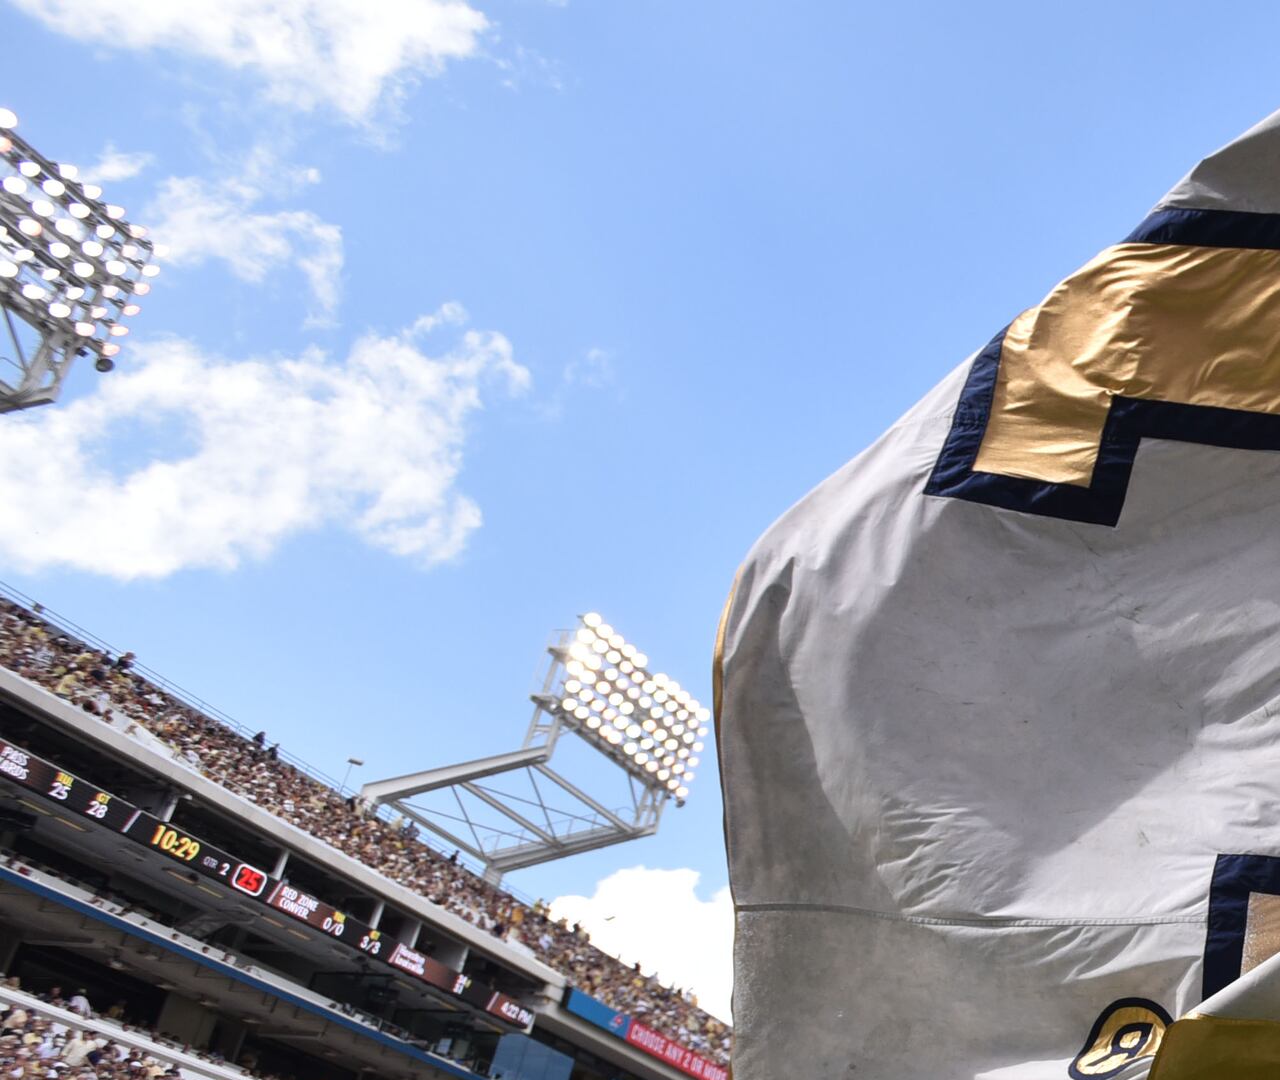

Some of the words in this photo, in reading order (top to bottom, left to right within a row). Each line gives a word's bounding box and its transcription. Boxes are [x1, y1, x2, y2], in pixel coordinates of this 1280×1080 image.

[0, 759, 29, 780] ARDS
[48, 782, 71, 800] 25
[85, 800, 108, 819] 28
[151, 824, 200, 861] 10:29
[219, 862, 230, 876] 2
[237, 867, 262, 893] 25
[281, 886, 298, 901] RED
[297, 894, 319, 912] ZONE
[322, 917, 344, 936] 0/0
[360, 935, 381, 954] 3/3
[630, 1022, 666, 1056] CHOOSE
[664, 1044, 684, 1064] ANY
[683, 1053, 691, 1069] 2
[690, 1058, 704, 1075] OR
